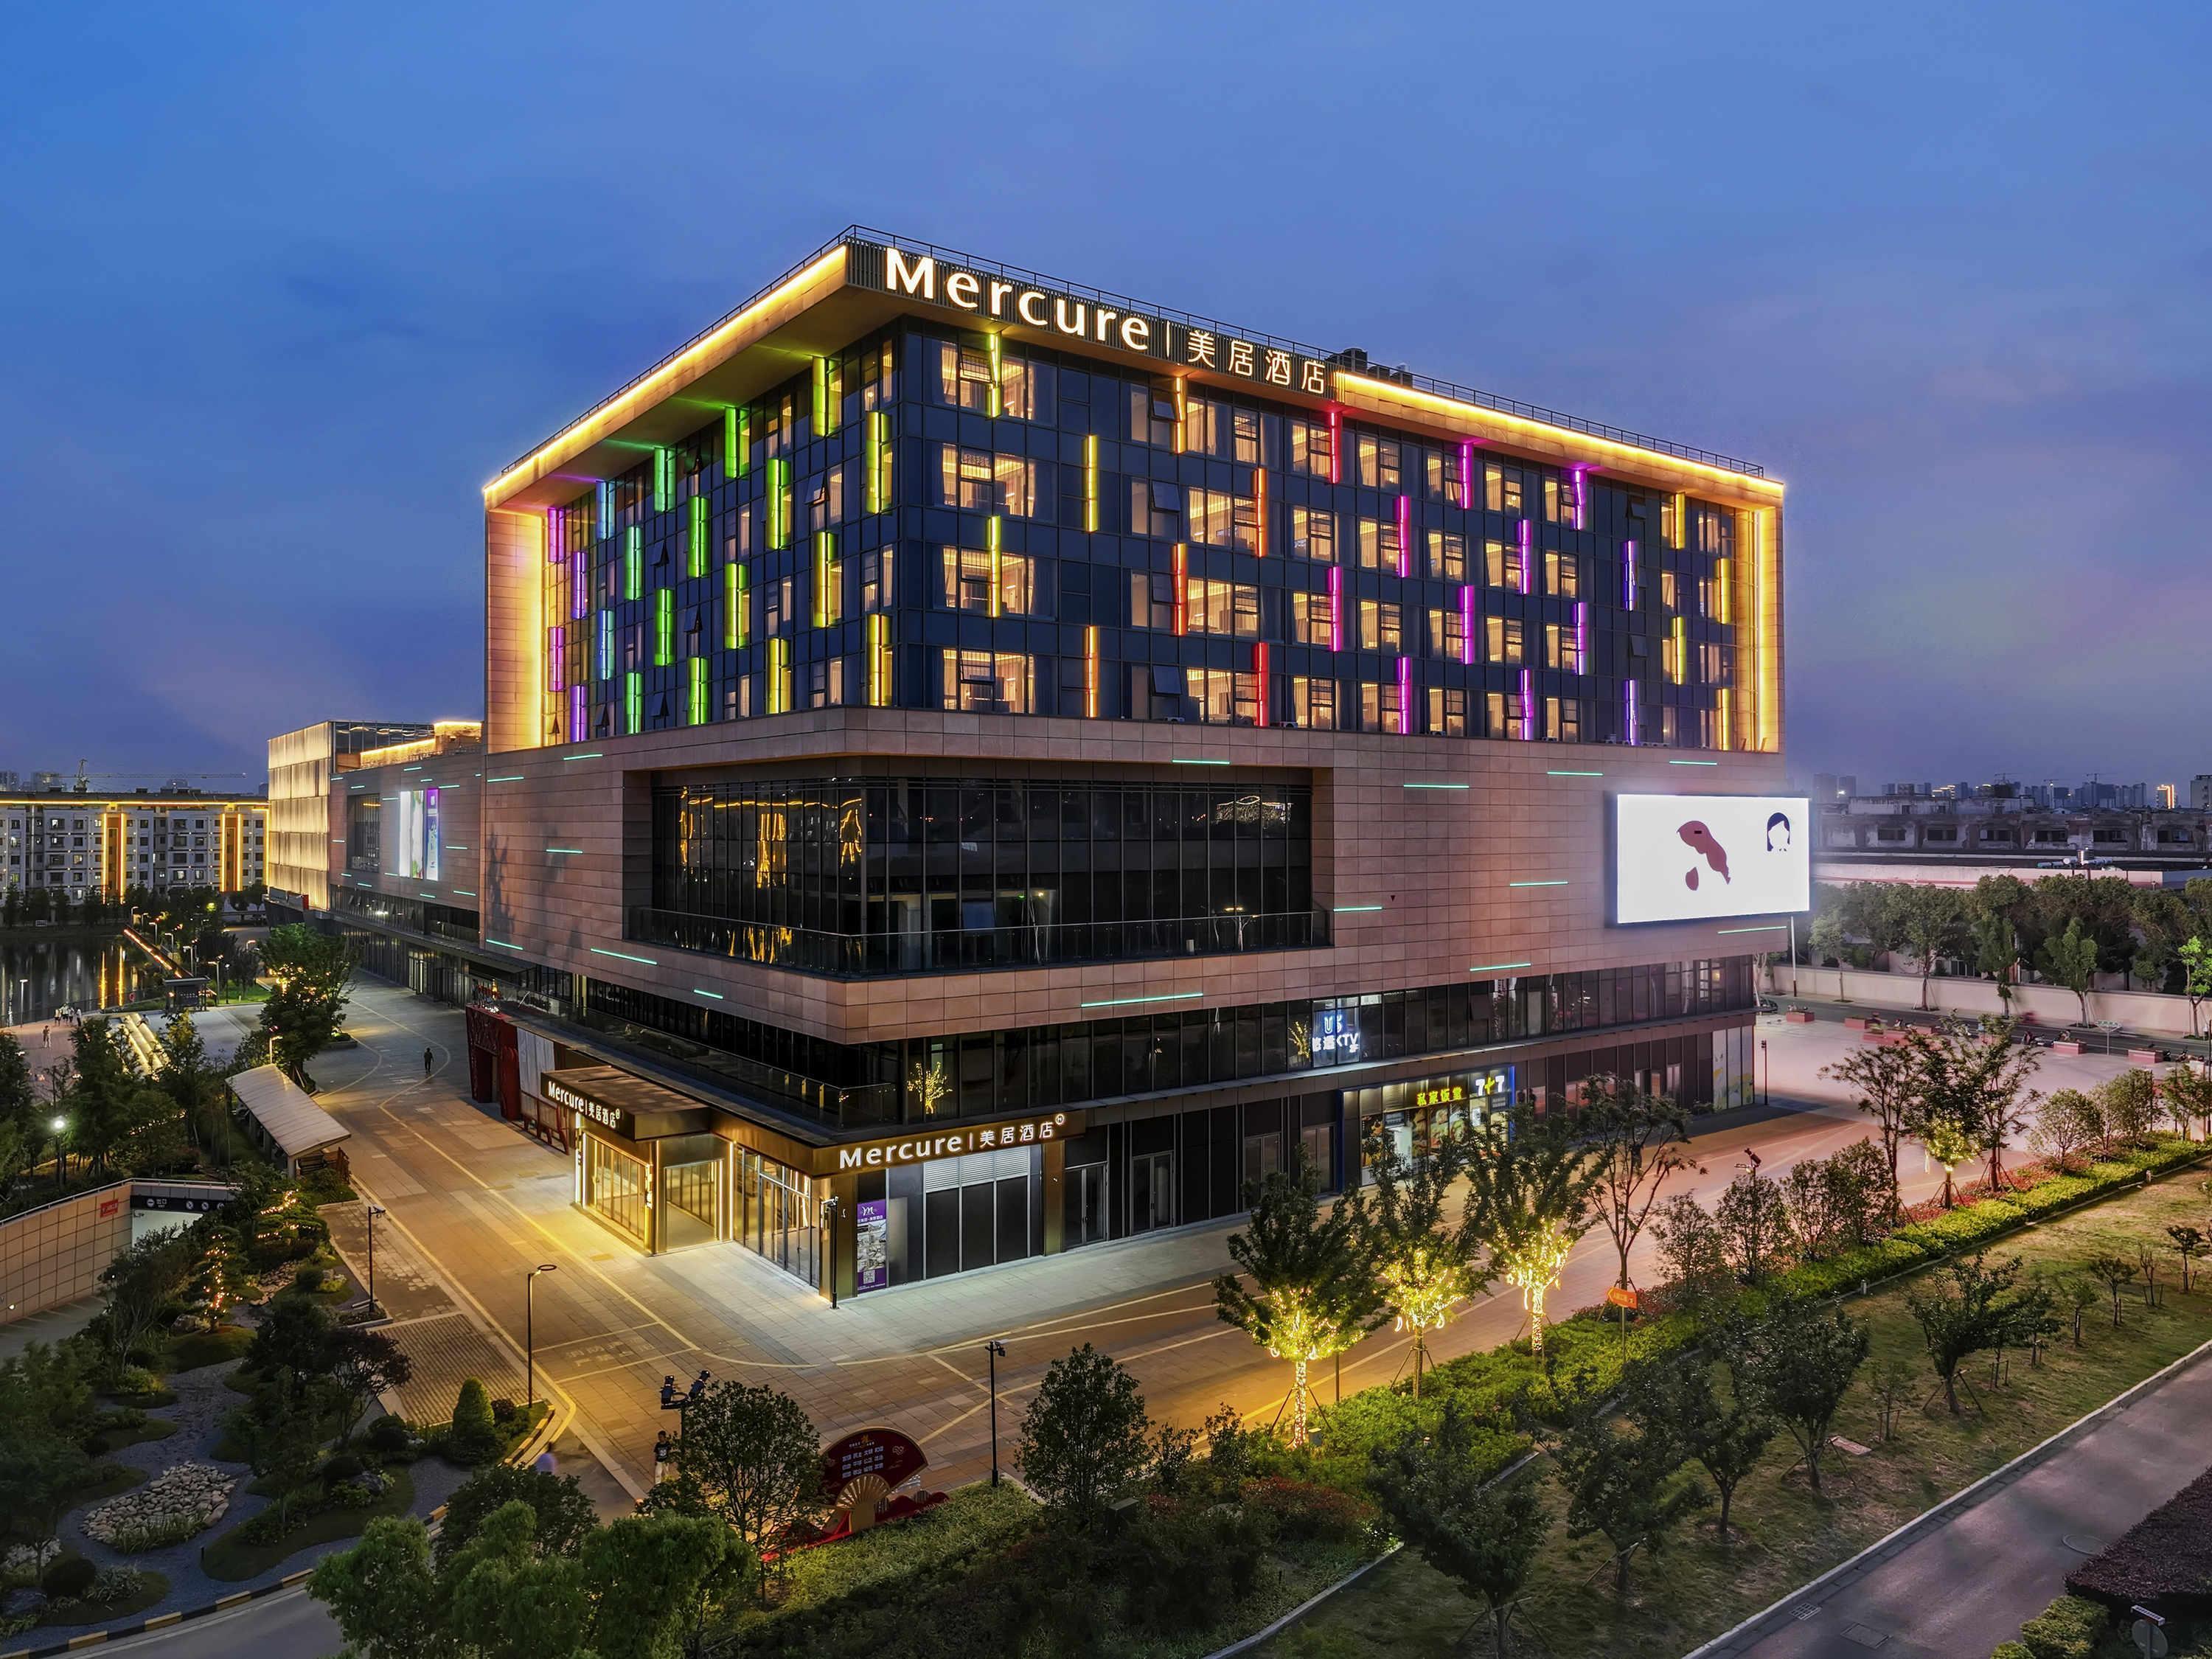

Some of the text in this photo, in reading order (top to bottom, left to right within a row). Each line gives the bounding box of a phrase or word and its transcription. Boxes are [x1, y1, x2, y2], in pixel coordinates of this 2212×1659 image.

[886, 248, 1150, 351] Mercure
[1187, 329, 1326, 394] 美居酒店
[549, 1081, 584, 1112] Mercure
[588, 1101, 616, 1129] 美居酒店
[979, 1121, 1055, 1149] 美居酒店
[839, 1135, 962, 1169] Mercure
